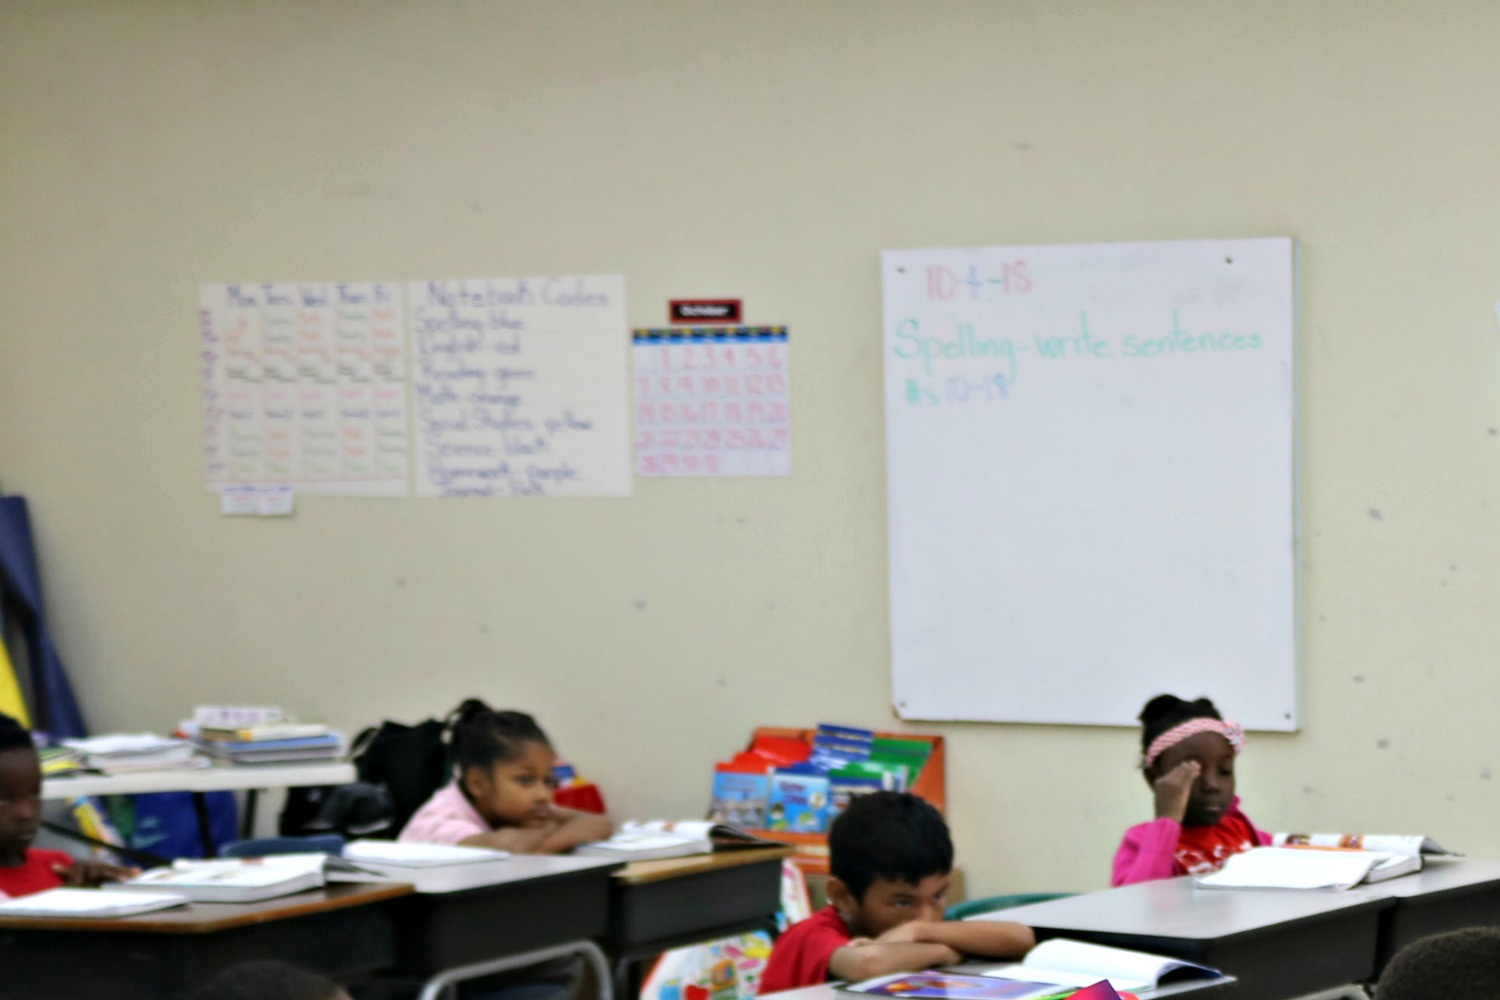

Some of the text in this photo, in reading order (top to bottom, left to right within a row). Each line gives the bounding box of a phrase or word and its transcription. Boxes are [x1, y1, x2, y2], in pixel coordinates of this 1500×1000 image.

[427, 278, 610, 308] Notebook Codes
[1120, 308, 1263, 357] sentences
[660, 347, 672, 369] 1
[682, 346, 697, 370] 2
[702, 344, 718, 369] 3
[745, 347, 763, 368] 5
[767, 344, 783, 368] 6
